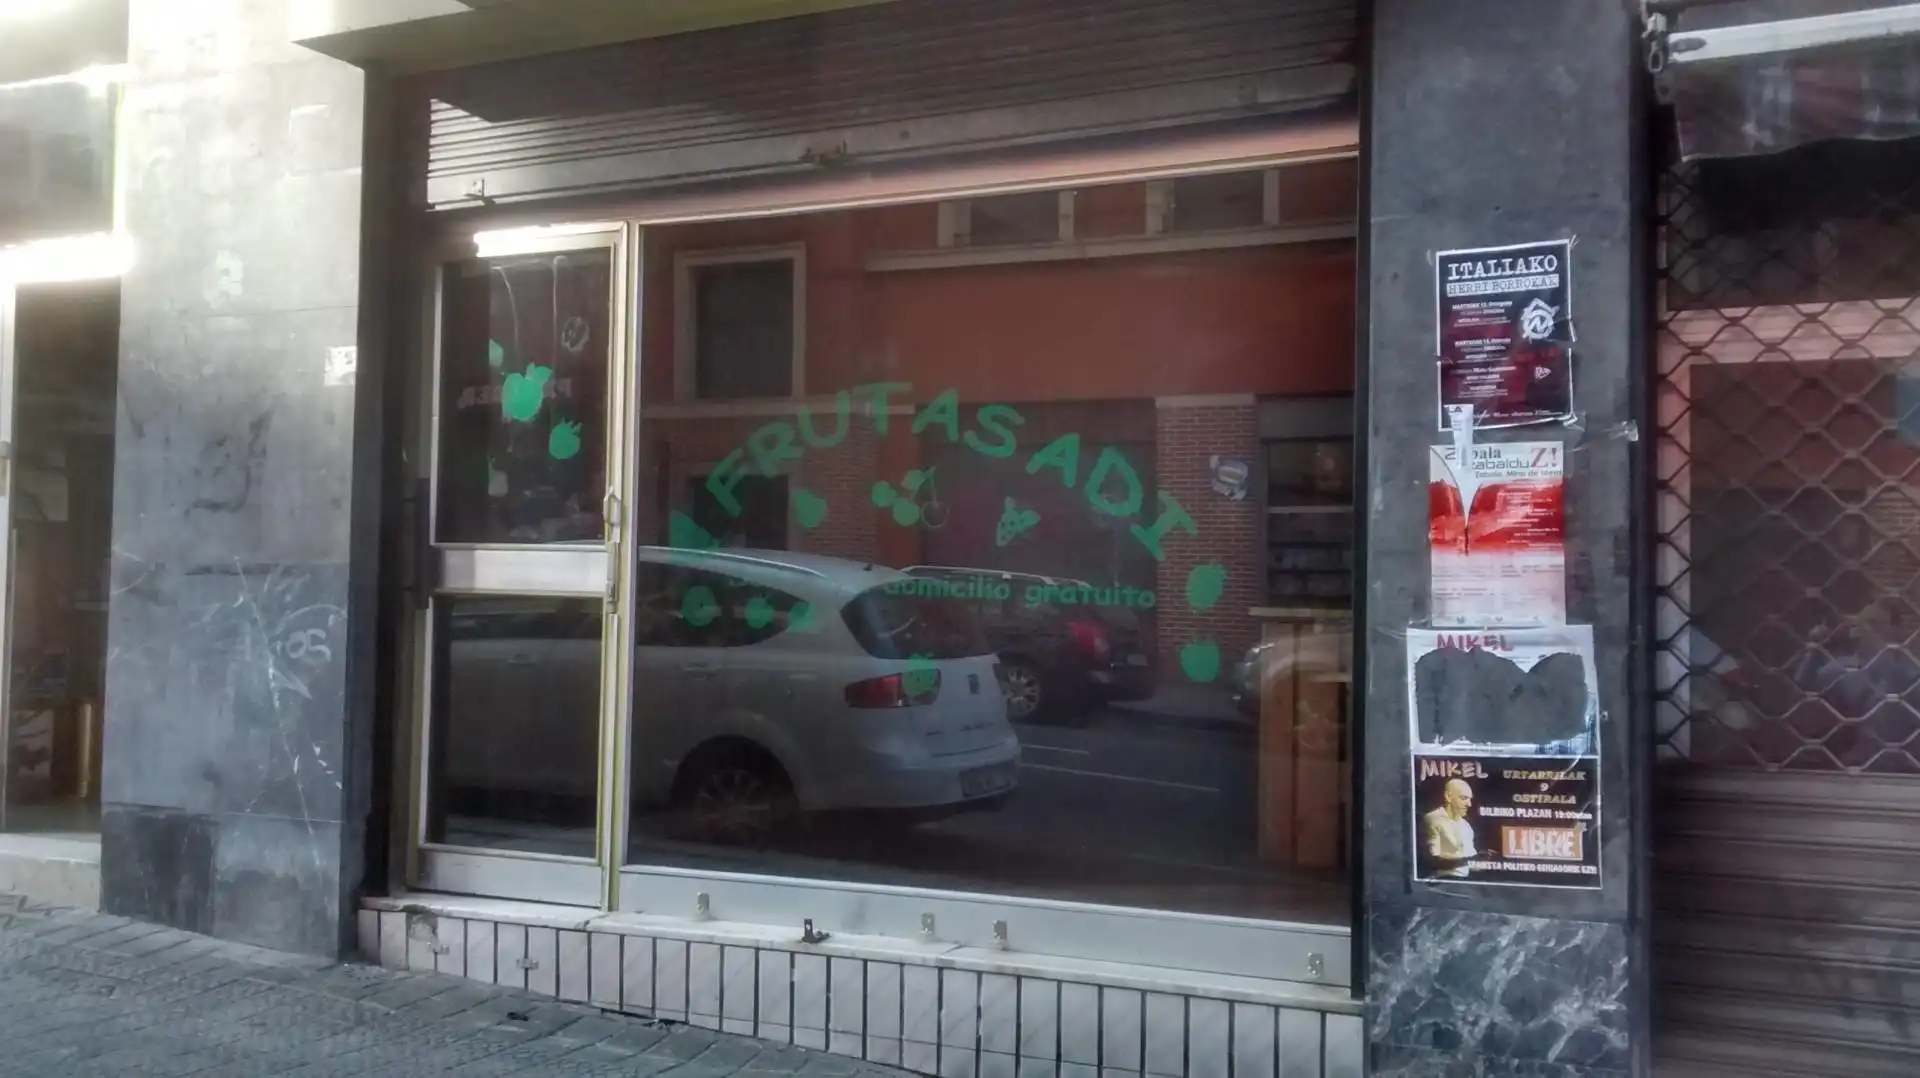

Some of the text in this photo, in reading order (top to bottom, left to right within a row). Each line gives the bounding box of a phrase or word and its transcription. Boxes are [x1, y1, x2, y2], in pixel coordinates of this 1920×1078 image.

[1448, 254, 1558, 280] ITALIAKO
[1448, 283, 1489, 296] HERRI
[706, 381, 1025, 516] FRUTAS
[885, 575, 1156, 609] domicilio gratuito
[1437, 633, 1515, 652] MIKEL
[1421, 760, 1488, 780] MIKEL
[1508, 828, 1576, 857] LIBRE
